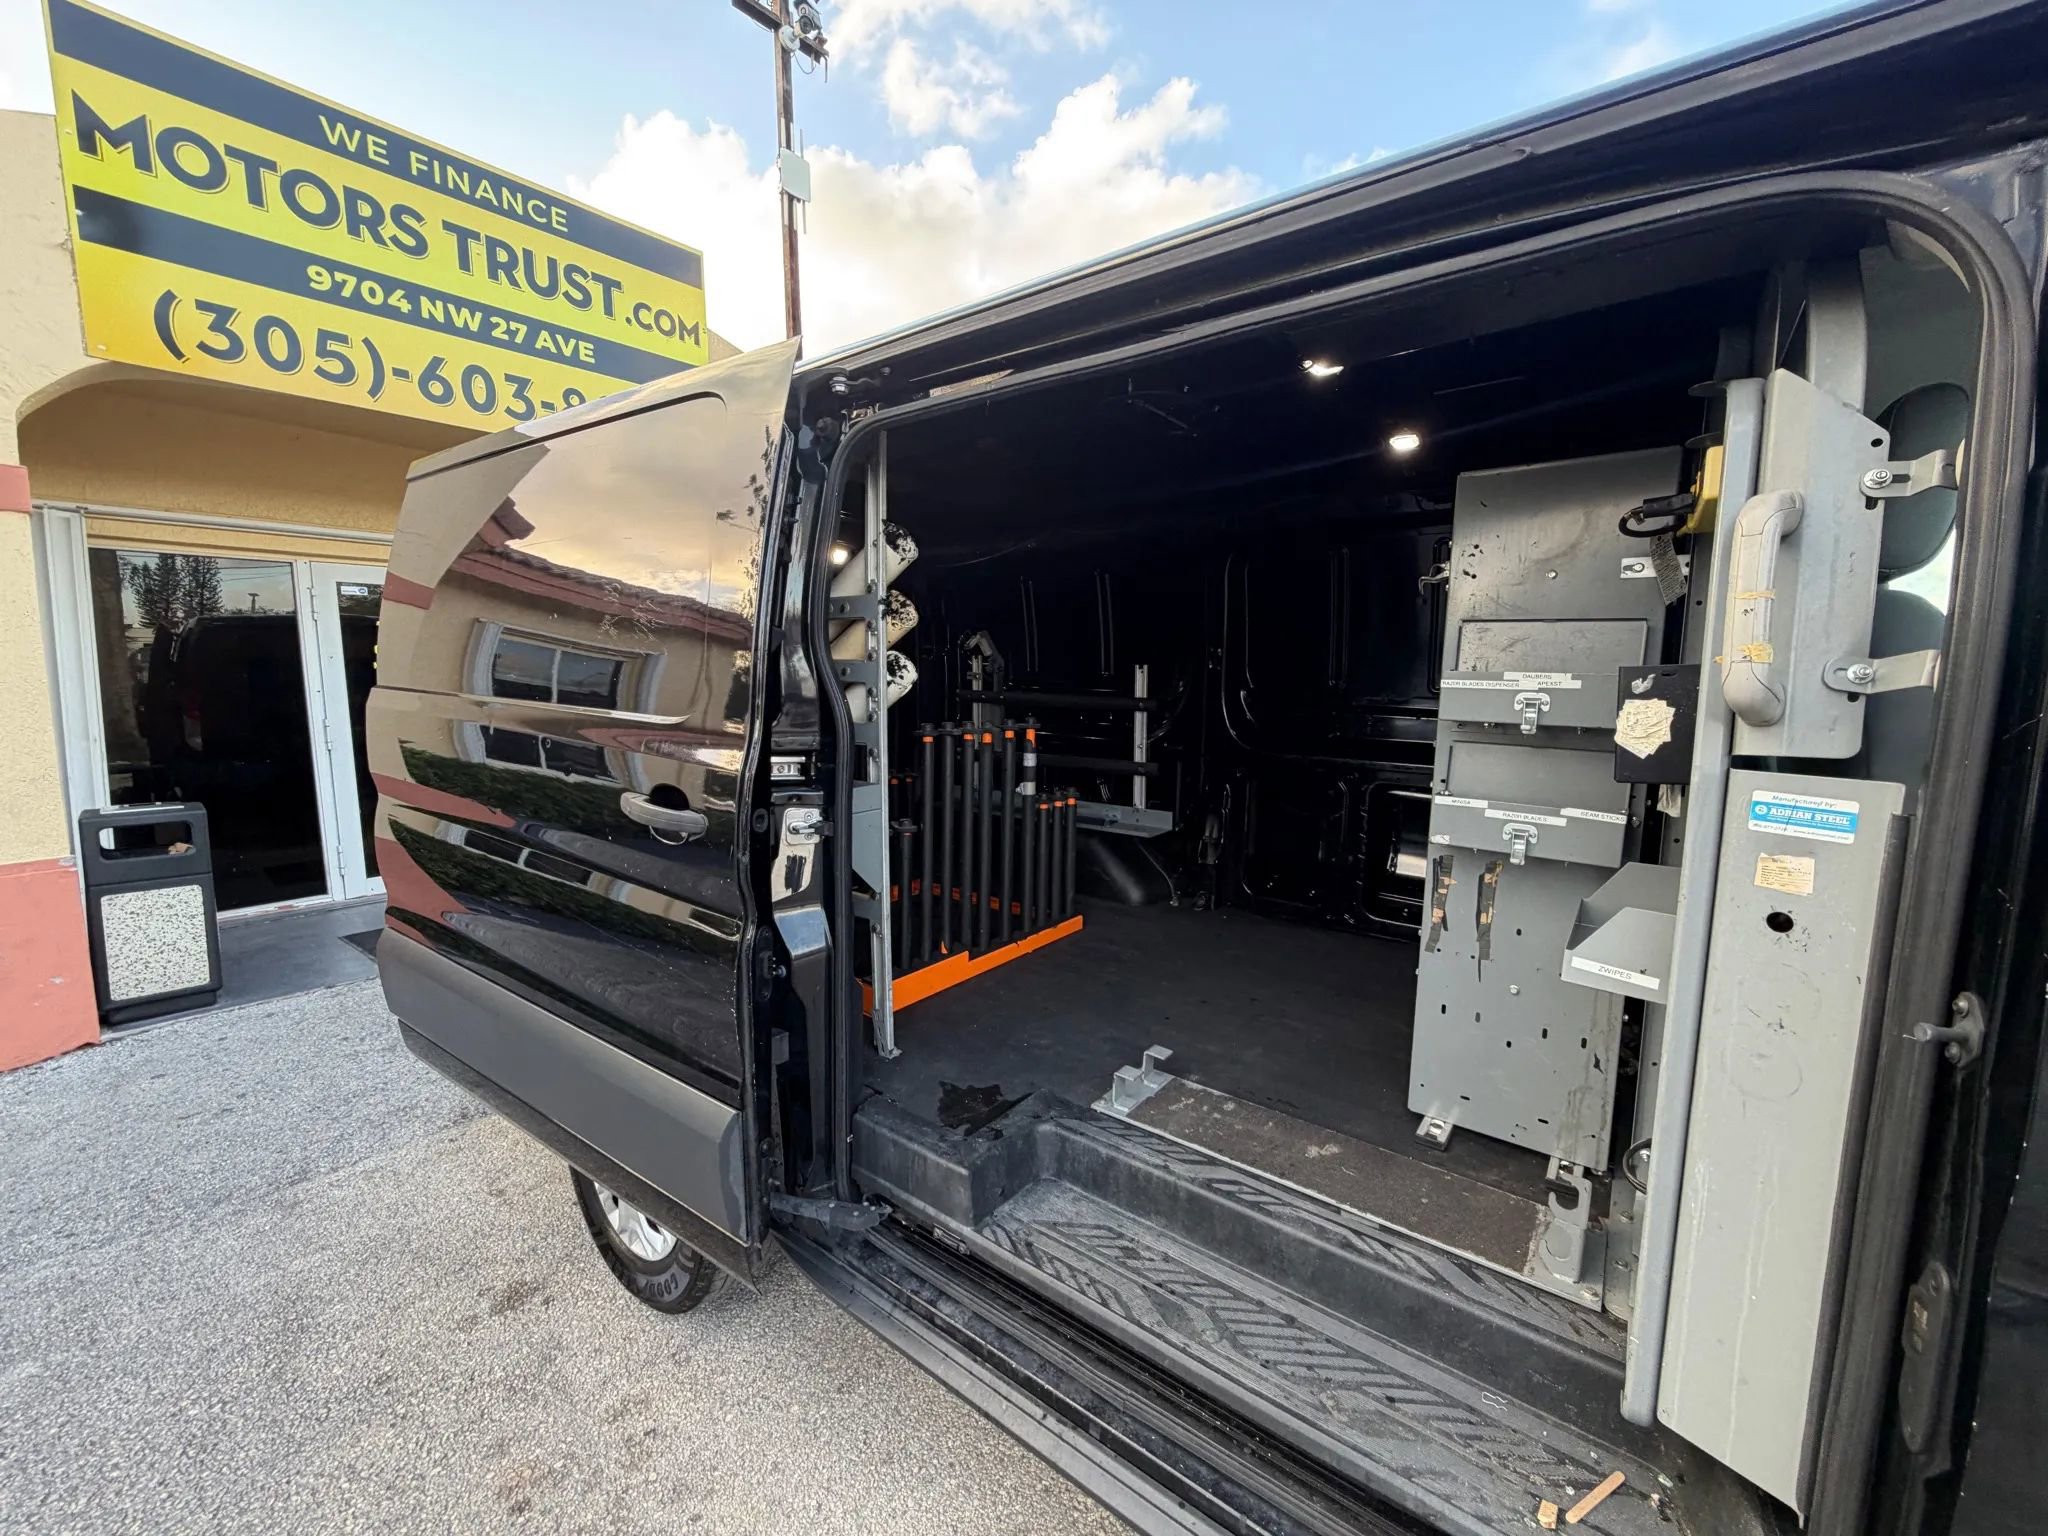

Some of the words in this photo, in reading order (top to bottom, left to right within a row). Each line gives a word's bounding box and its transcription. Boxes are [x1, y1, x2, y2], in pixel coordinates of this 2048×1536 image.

[71, 88, 430, 260] MOTORS
[441, 218, 702, 347] TRUST.COM
[318, 115, 390, 165] WE
[409, 151, 569, 232] FINANCE
[153, 288, 590, 423] (305)-603-
[306, 264, 412, 314] 9704
[419, 295, 483, 332] NW
[489, 316, 528, 343] 27
[534, 330, 596, 364] AVE
[1601, 814, 1625, 823] STICKS
[1769, 807, 1813, 821] ADRIAN
[1813, 814, 1850, 825] STEEL
[1598, 965, 1632, 980] ZWIPES
